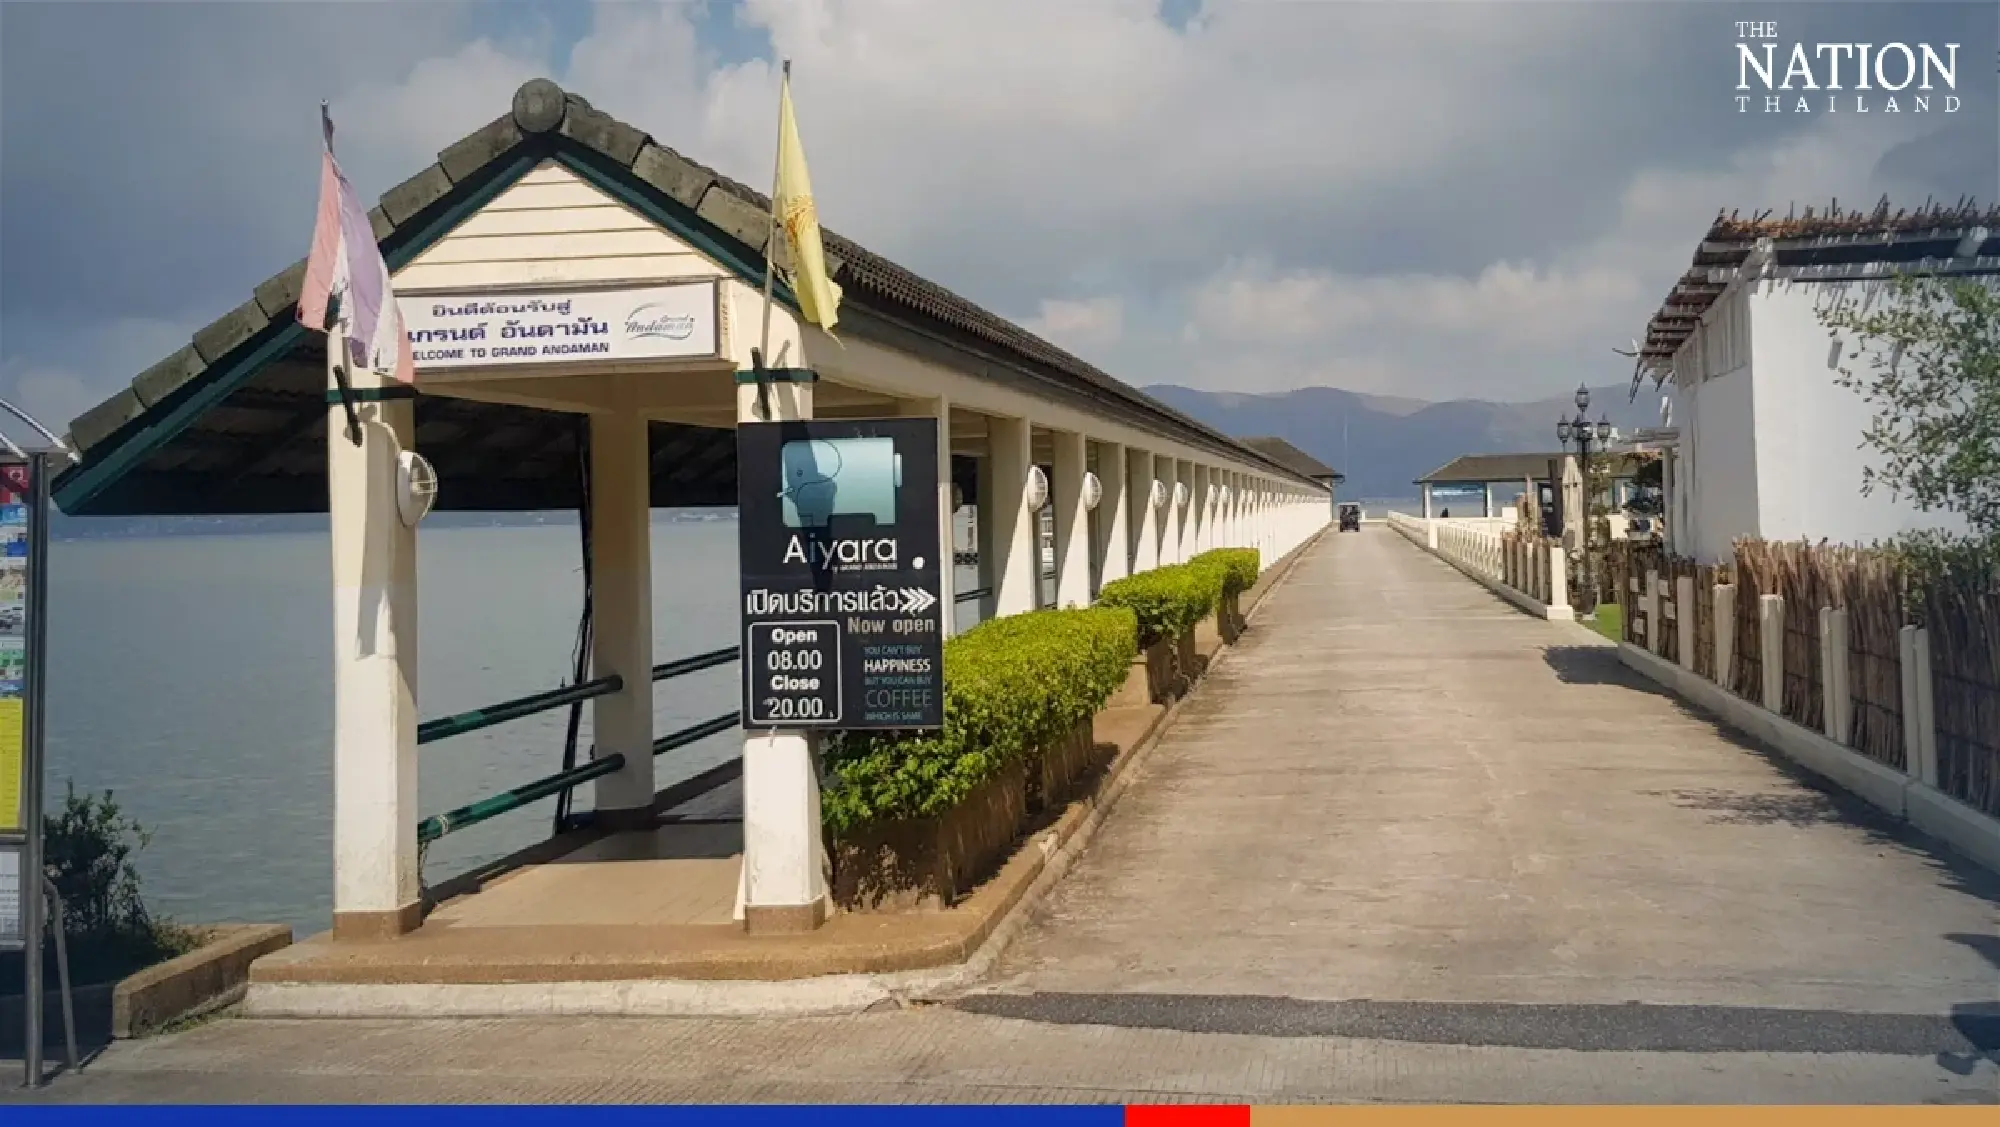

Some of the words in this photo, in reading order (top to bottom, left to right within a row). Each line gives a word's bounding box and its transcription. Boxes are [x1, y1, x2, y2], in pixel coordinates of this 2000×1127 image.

[501, 316, 609, 339] อันดามัน
[412, 348, 464, 361] ELCOME
[470, 347, 486, 358] TO
[491, 346, 538, 358] GRAND
[542, 342, 610, 356] ANDAMAN
[782, 533, 898, 570] Aiyara
[746, 584, 899, 615] เปิดบริการแล้ว
[771, 627, 818, 646] Open
[847, 616, 886, 634] Now
[892, 618, 936, 636] open
[767, 649, 823, 671] 08.00
[864, 658, 931, 673] HAPPINESS
[771, 674, 820, 692] Close
[766, 696, 823, 719] 20.00
[865, 688, 933, 709] COFFEE
